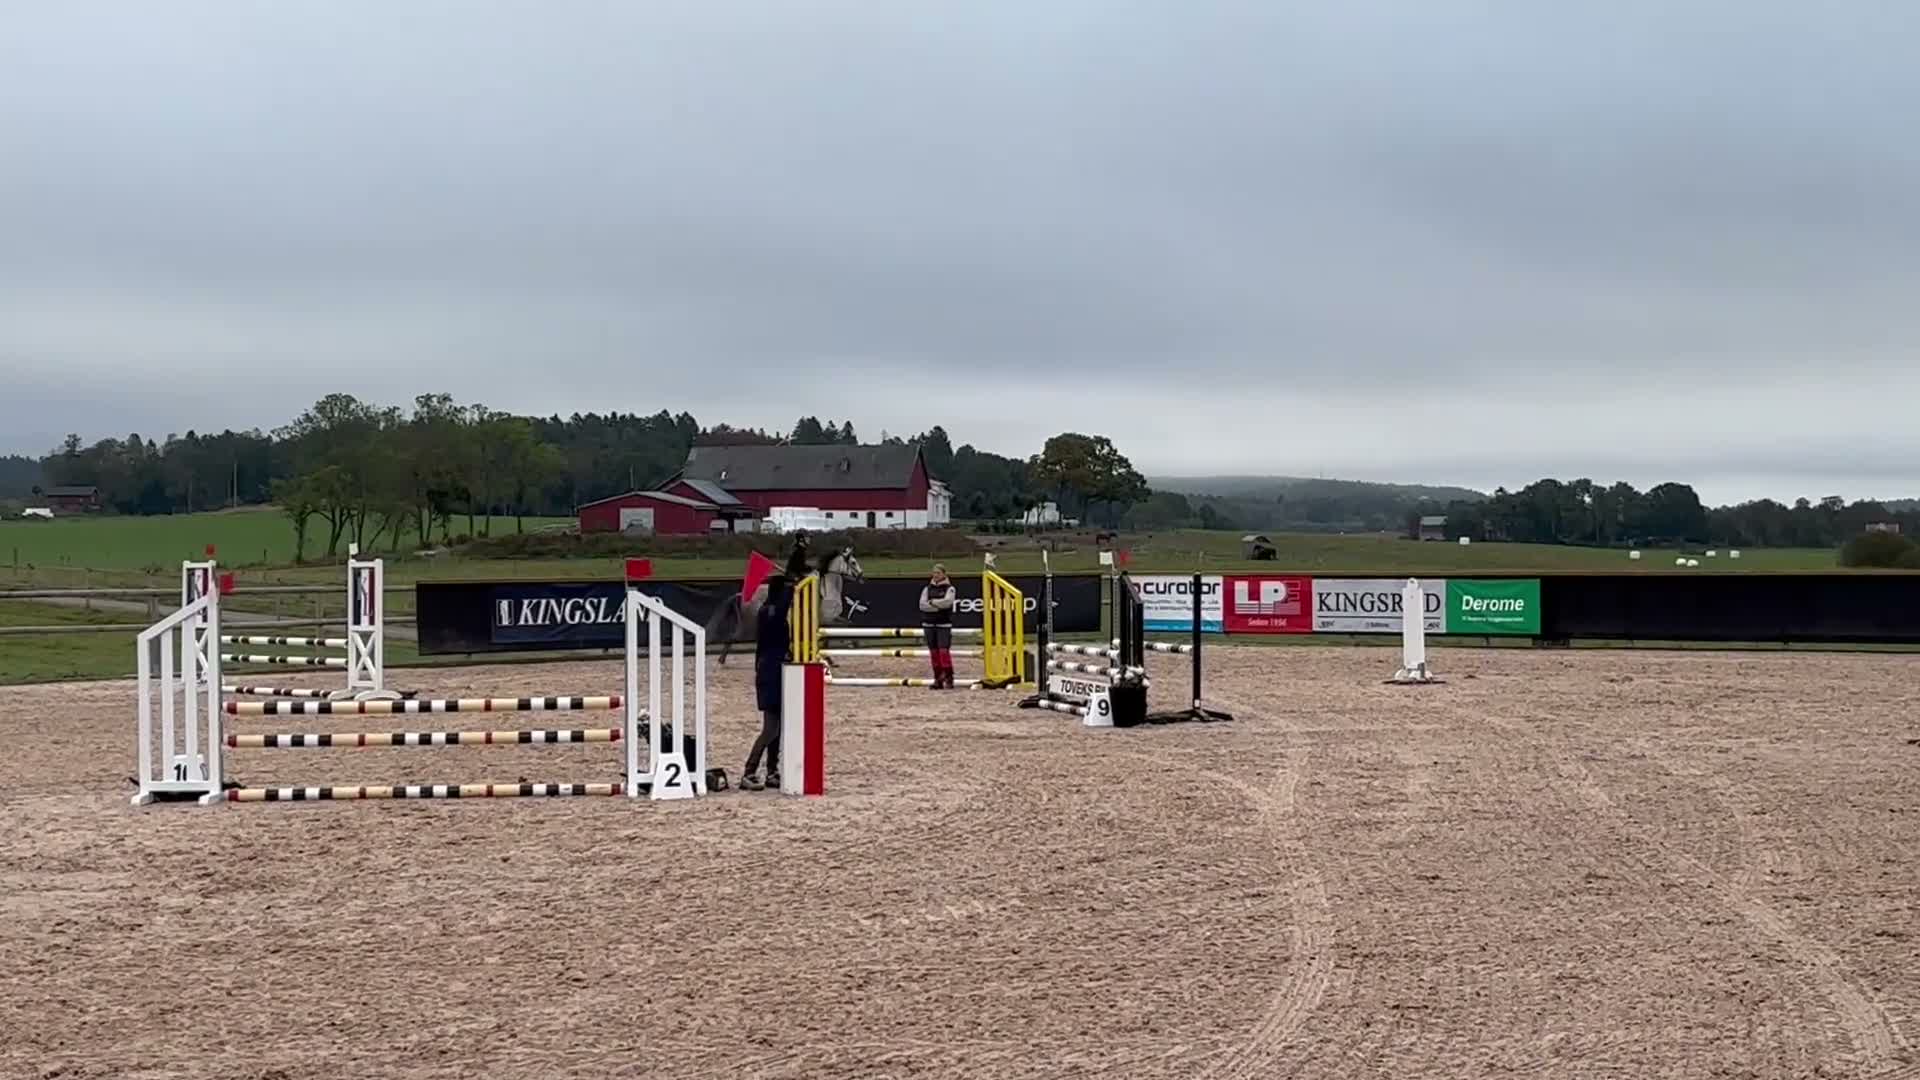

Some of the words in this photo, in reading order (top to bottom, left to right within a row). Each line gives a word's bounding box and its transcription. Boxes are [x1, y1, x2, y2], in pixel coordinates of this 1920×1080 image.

[1317, 592, 1440, 613] KINGSRD
[1462, 595, 1524, 611] Derome
[1098, 699, 1109, 716] 9
[664, 763, 681, 787] 2
